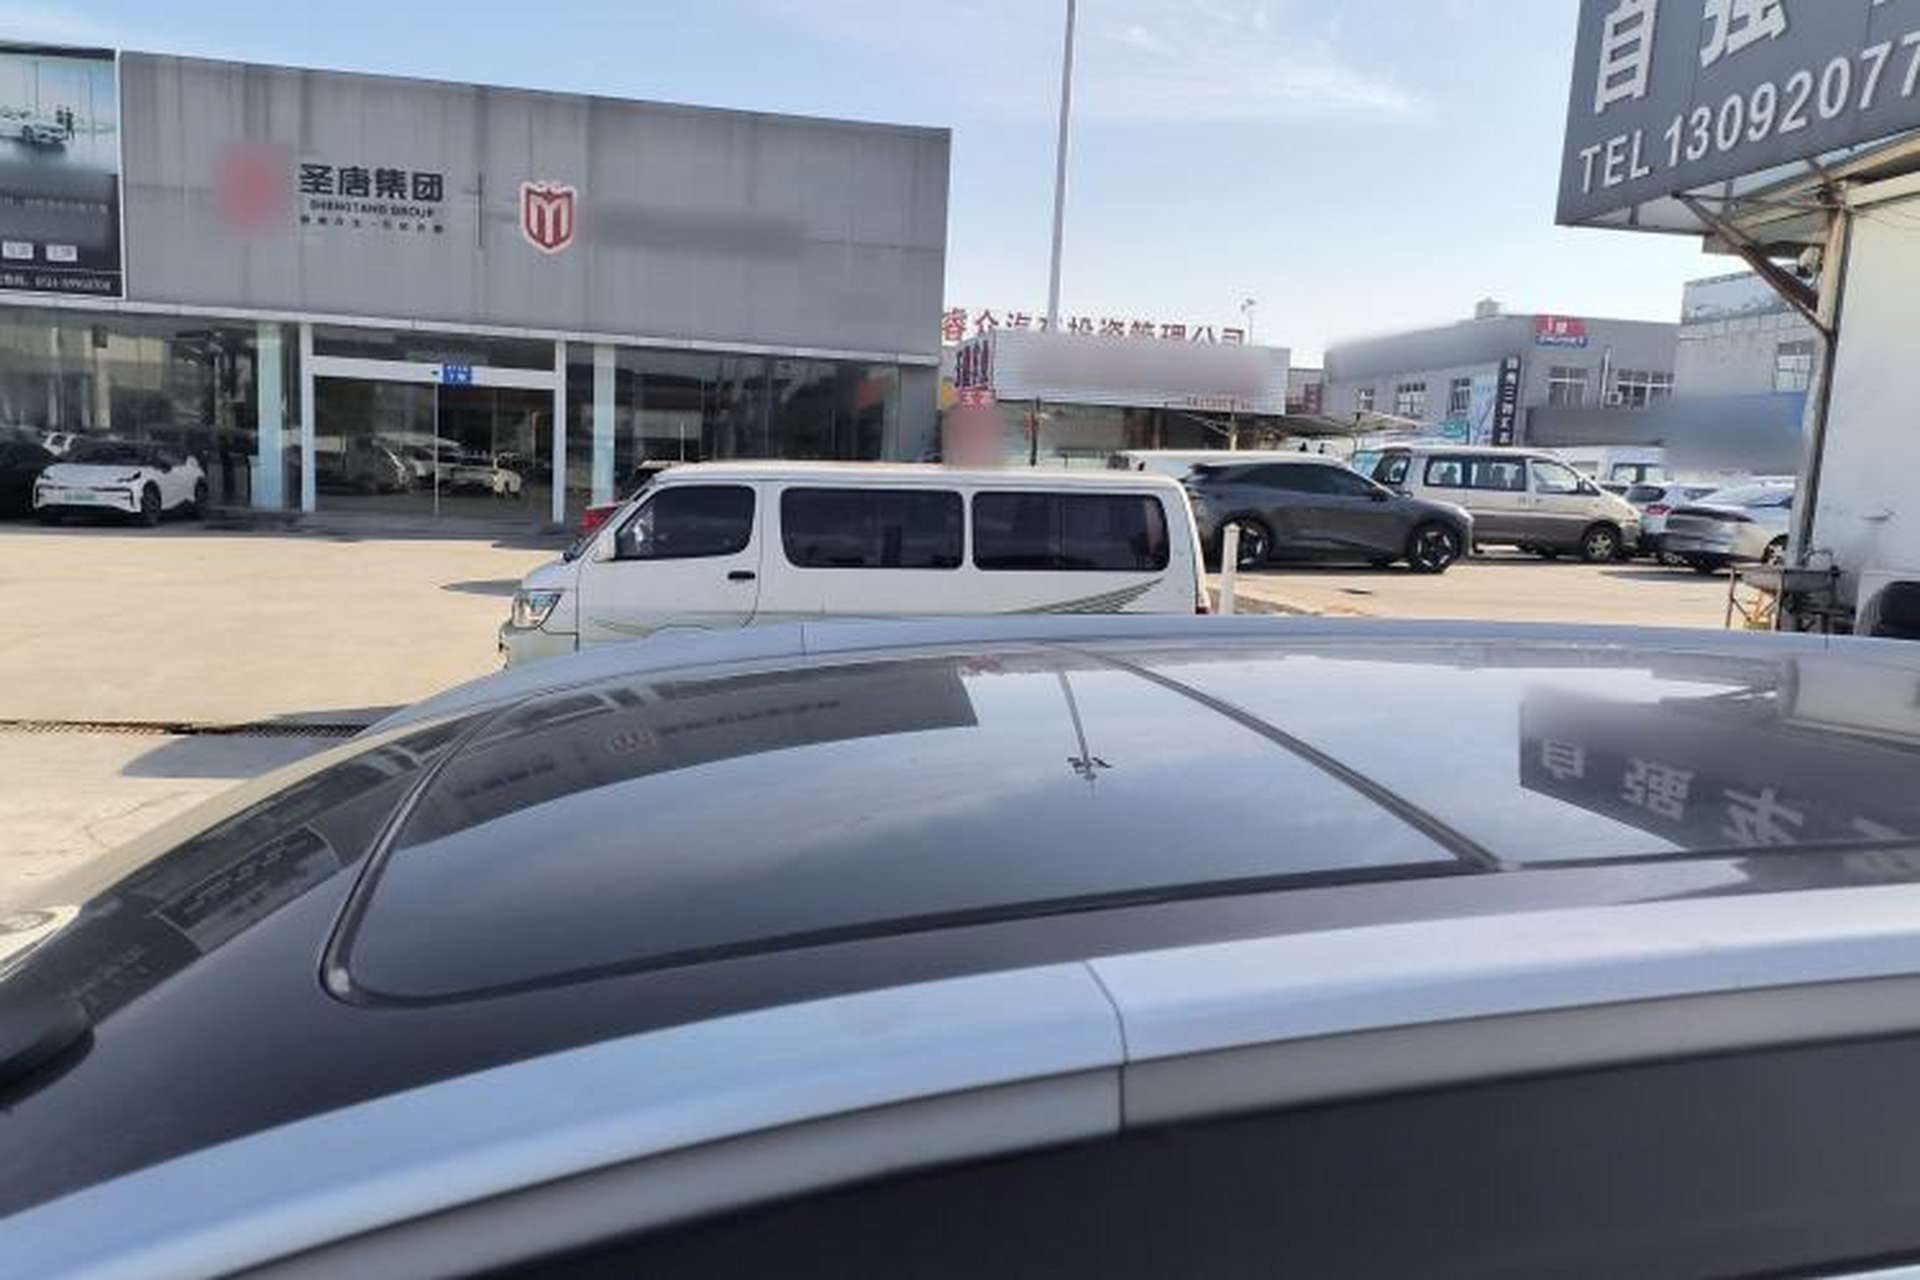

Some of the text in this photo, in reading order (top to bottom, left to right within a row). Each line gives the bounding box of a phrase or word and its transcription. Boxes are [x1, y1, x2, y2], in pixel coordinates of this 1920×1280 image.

[299, 163, 444, 202] 圣唐集团
[1579, 129, 1651, 194] TEL
